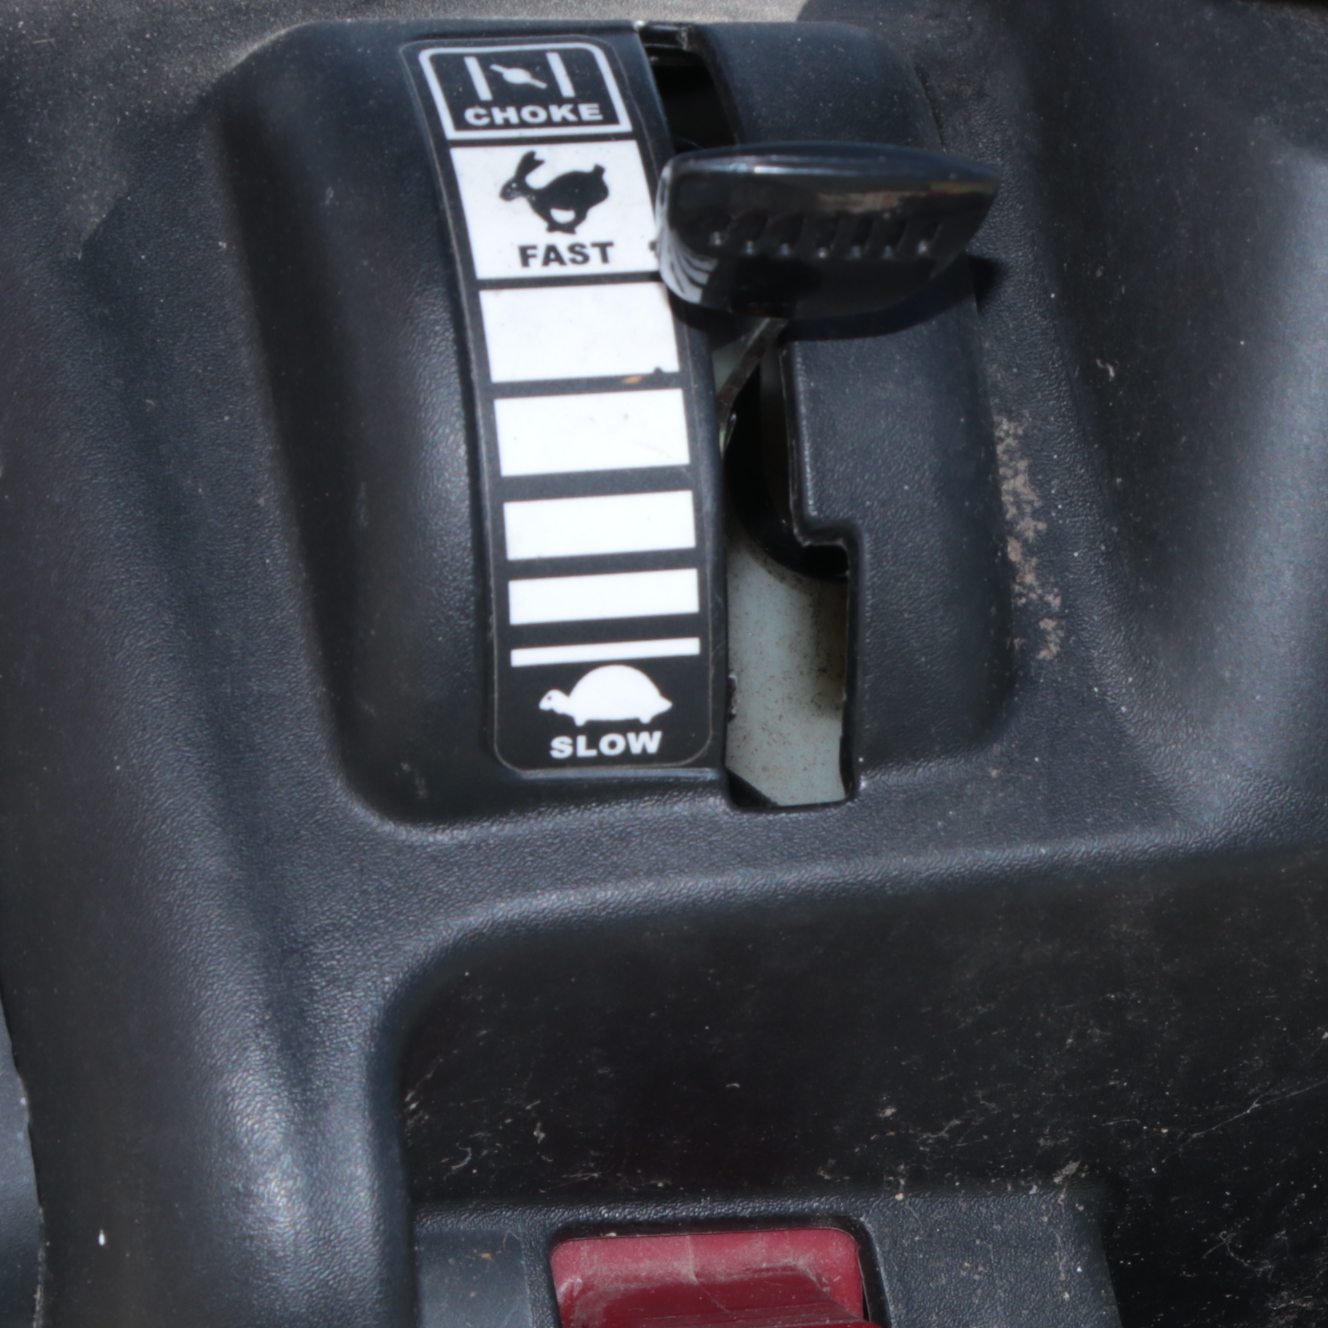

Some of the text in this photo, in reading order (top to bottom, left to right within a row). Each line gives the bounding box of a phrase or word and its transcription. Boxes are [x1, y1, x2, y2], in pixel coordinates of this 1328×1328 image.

[464, 103, 603, 126] CHOKE
[518, 241, 614, 268] FAST
[550, 730, 662, 759] SLOW
